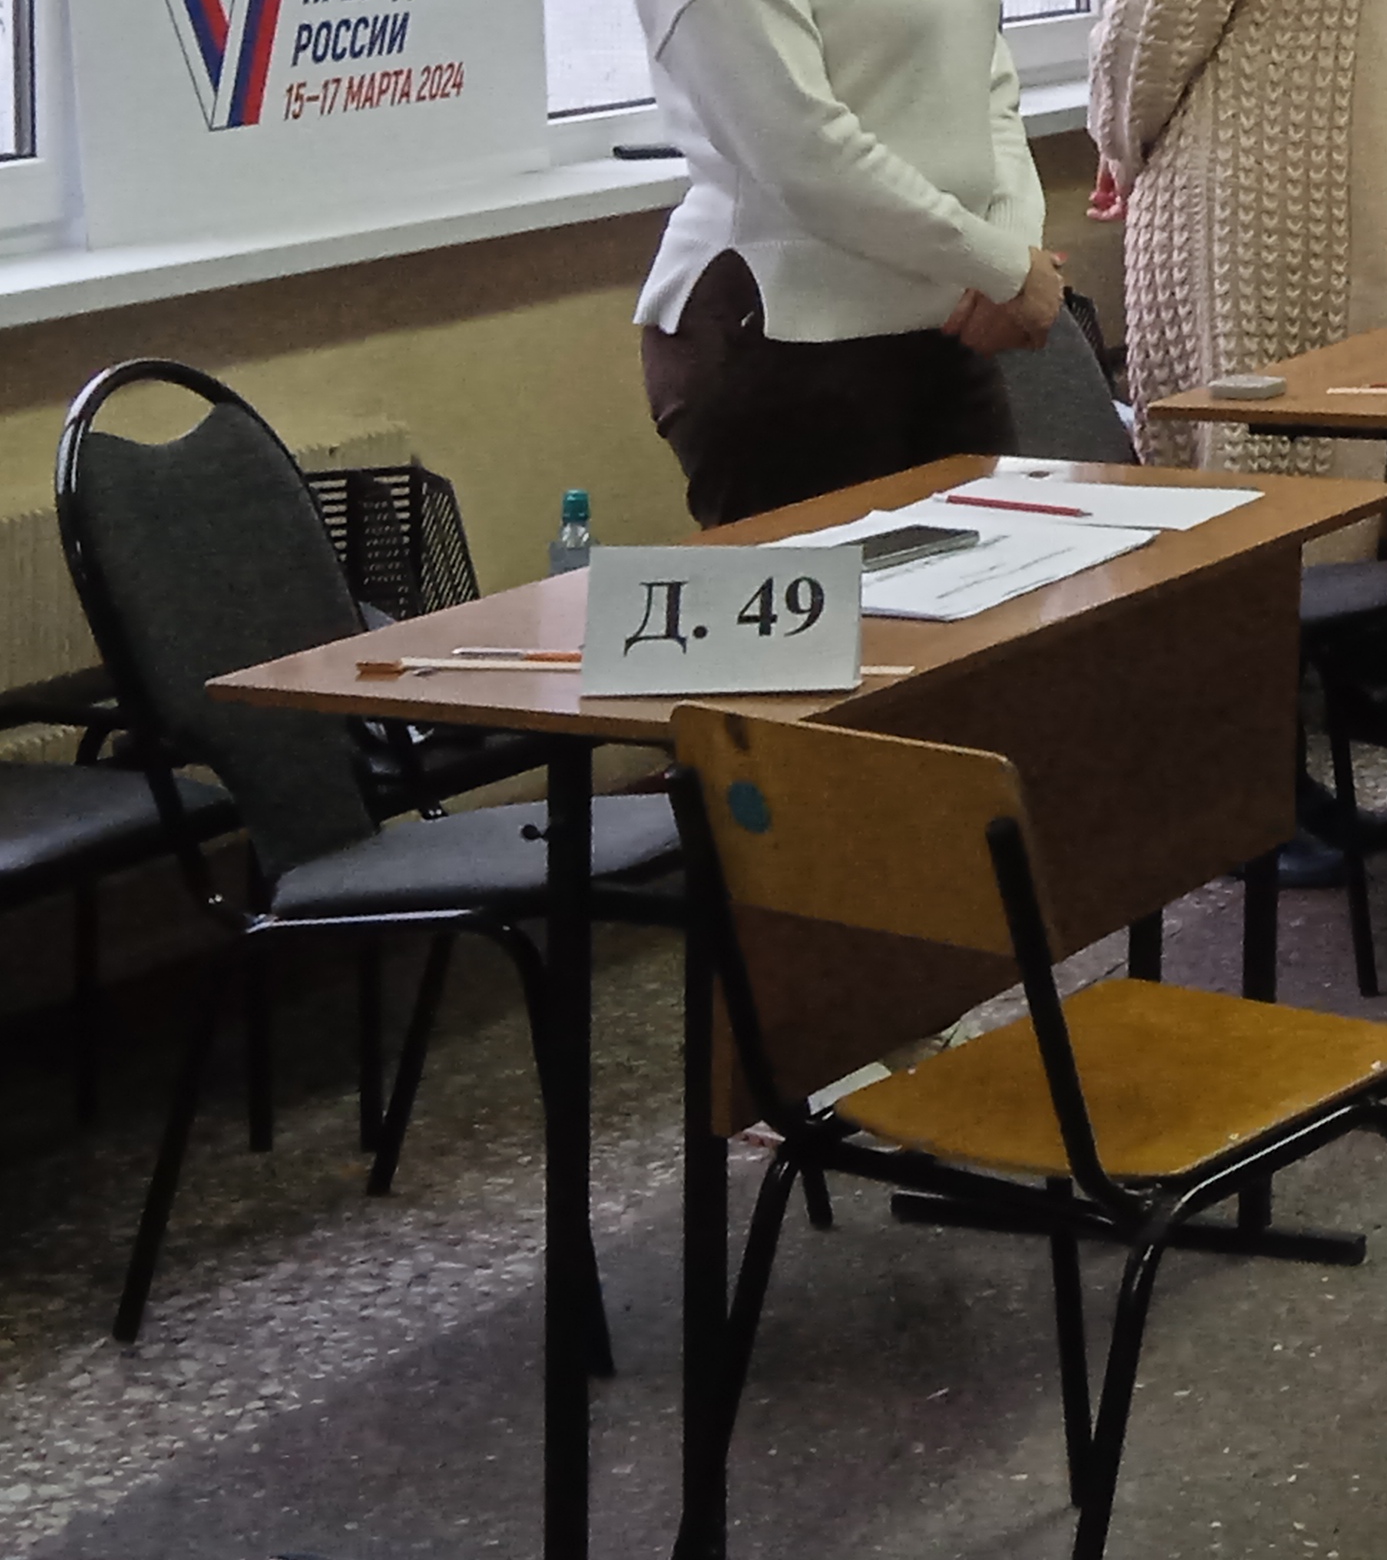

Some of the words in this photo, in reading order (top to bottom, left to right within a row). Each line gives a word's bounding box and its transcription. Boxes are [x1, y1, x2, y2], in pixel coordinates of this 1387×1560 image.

[290, 12, 410, 67] РОССИИ
[343, 67, 412, 113] МАРТА
[415, 61, 465, 102] 2024
[623, 580, 709, 657] Д.
[736, 576, 825, 637] 49
